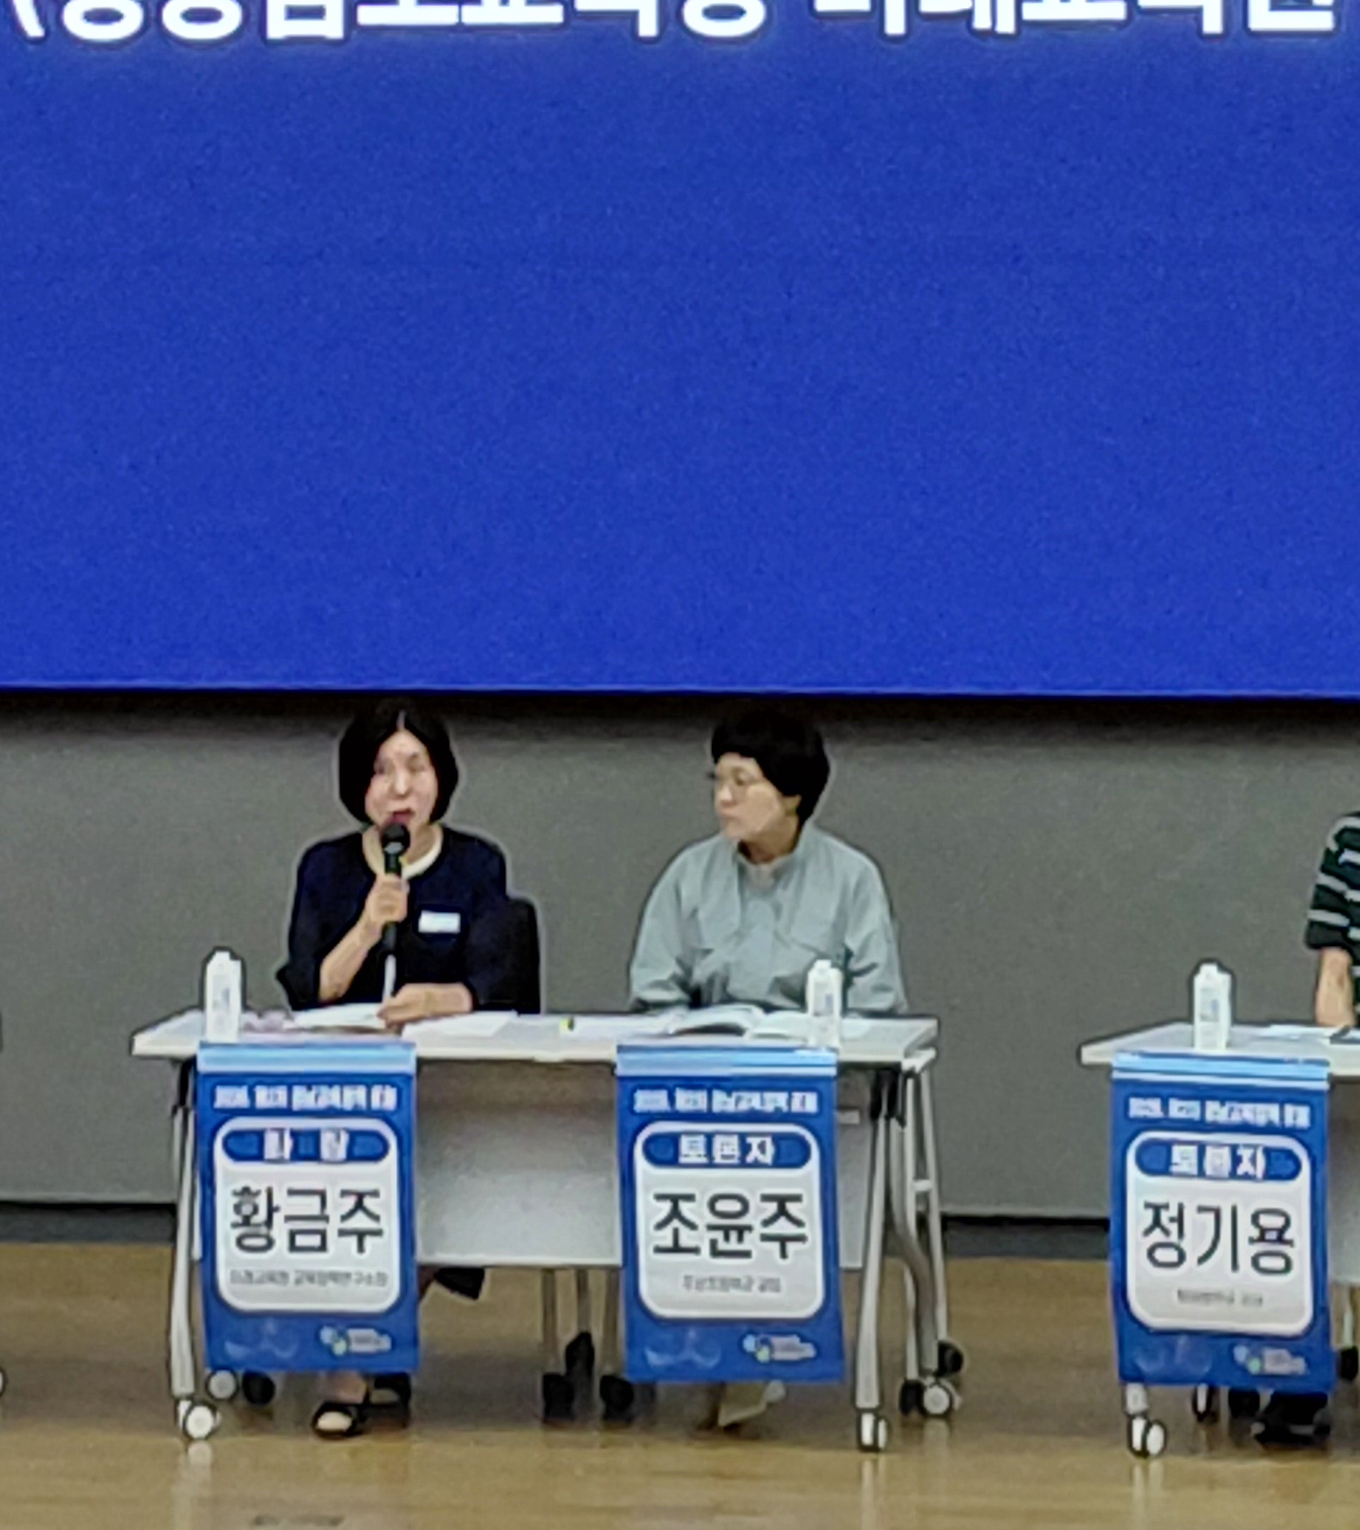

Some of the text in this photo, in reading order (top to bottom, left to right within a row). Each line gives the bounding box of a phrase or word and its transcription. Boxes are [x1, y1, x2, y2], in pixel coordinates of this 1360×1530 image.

[230, 1186, 384, 1254] 황금주
[653, 1192, 808, 1260] 조윤주
[1142, 1202, 1295, 1275] 정기용
